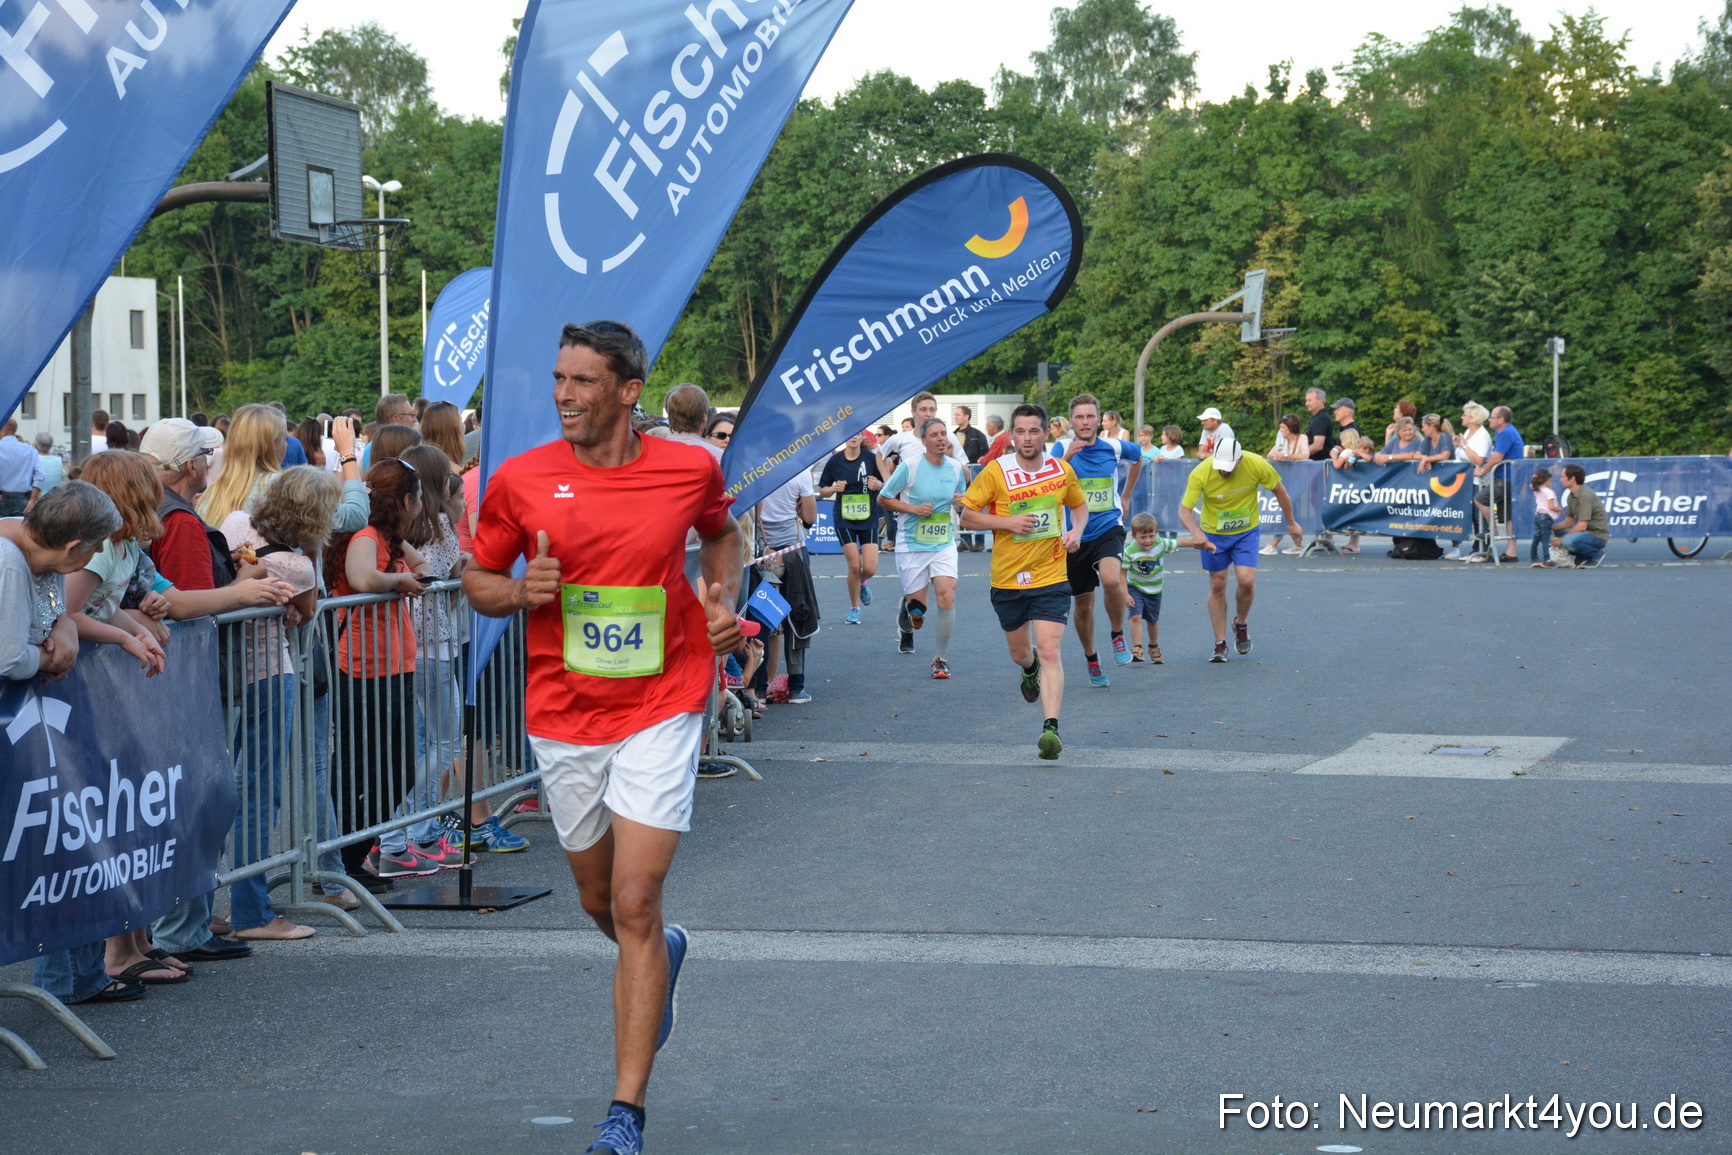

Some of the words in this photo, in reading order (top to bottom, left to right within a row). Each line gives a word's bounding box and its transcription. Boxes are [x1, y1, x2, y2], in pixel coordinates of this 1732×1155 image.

[594, 0, 758, 220] Fisch
[665, 0, 801, 216] AUTOMOBIL
[918, 304, 969, 344] Druck
[969, 288, 1003, 315] und
[1002, 250, 1061, 297] Medien
[780, 264, 990, 405] Frischmann
[1009, 489, 1038, 502] MAX
[1087, 491, 1108, 502] 793
[1329, 483, 1430, 505] Frischmann
[845, 504, 868, 513] 1156
[1387, 505, 1412, 517] Druck
[1414, 506, 1430, 517] und
[1430, 507, 1464, 519] Medien
[920, 524, 947, 535] 1496
[1224, 520, 1244, 530] 622
[1608, 515, 1698, 526] UTOMOBILE
[583, 622, 644, 653] 964
[2, 758, 182, 862] Fischer
[20, 838, 177, 910] AUTOMOBILE
